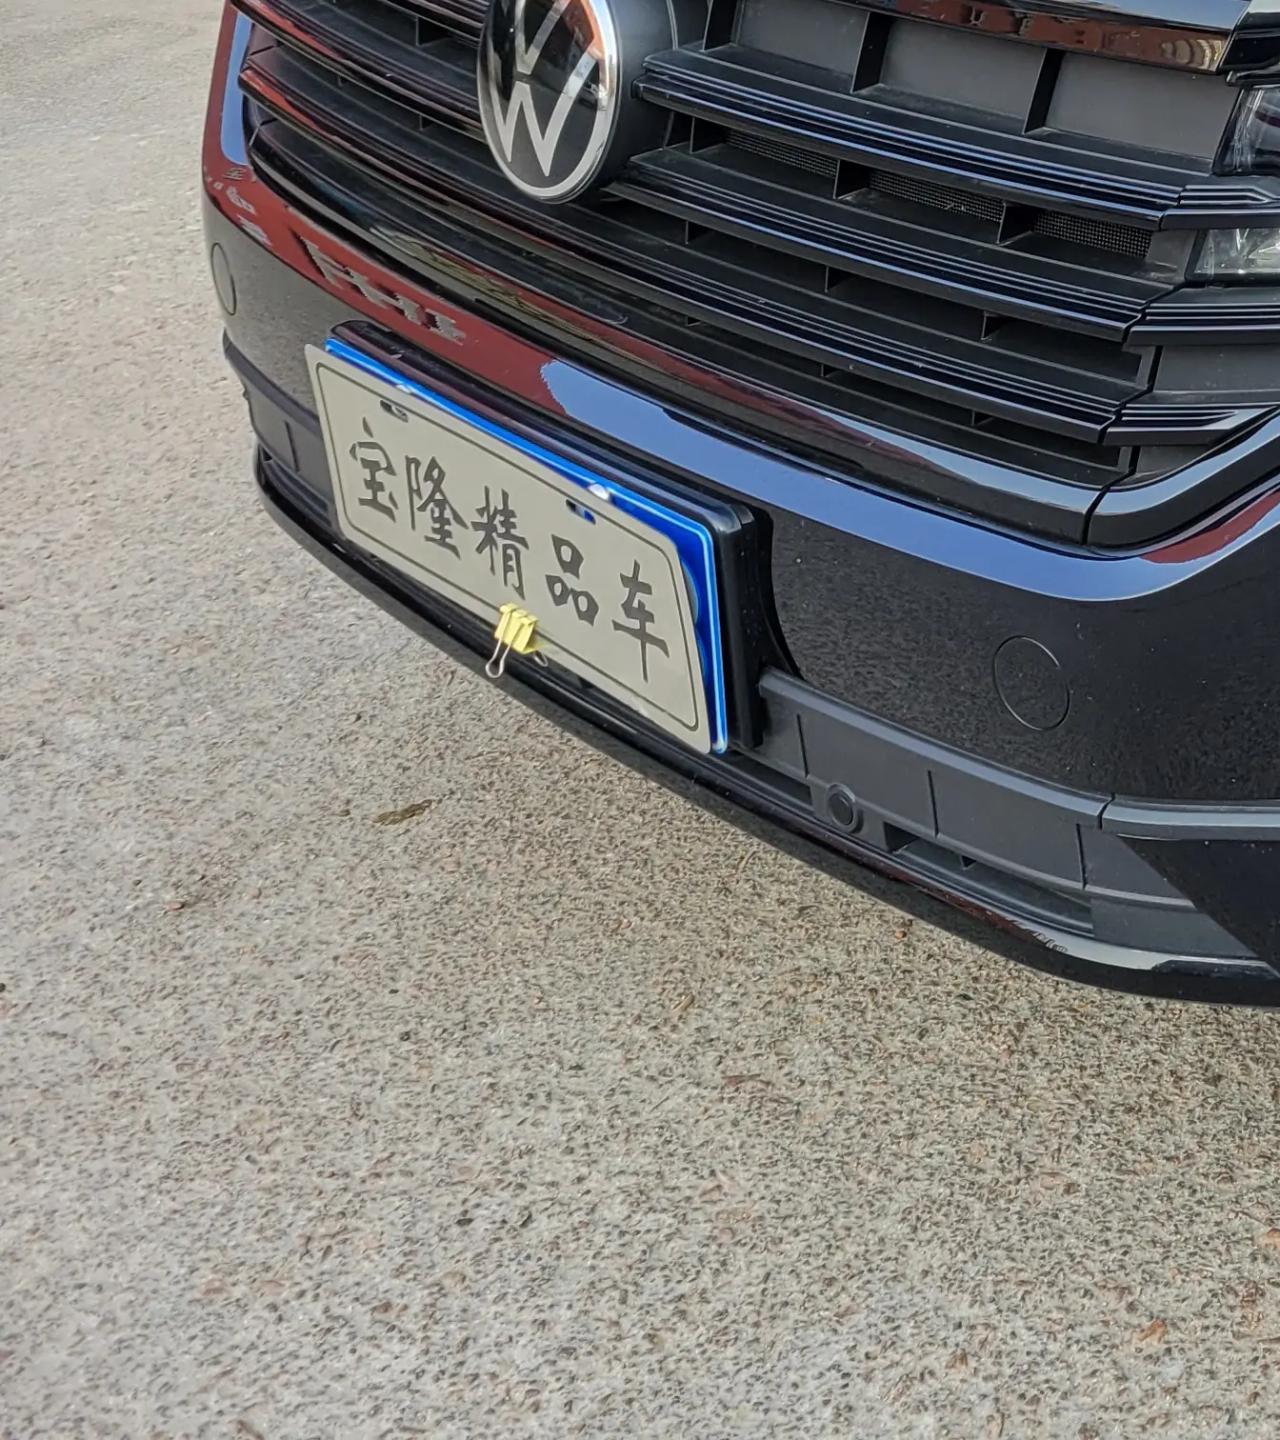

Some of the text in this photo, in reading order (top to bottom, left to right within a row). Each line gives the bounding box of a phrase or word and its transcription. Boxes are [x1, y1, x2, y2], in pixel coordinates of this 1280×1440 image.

[350, 417, 670, 682] 宝隆精品车
